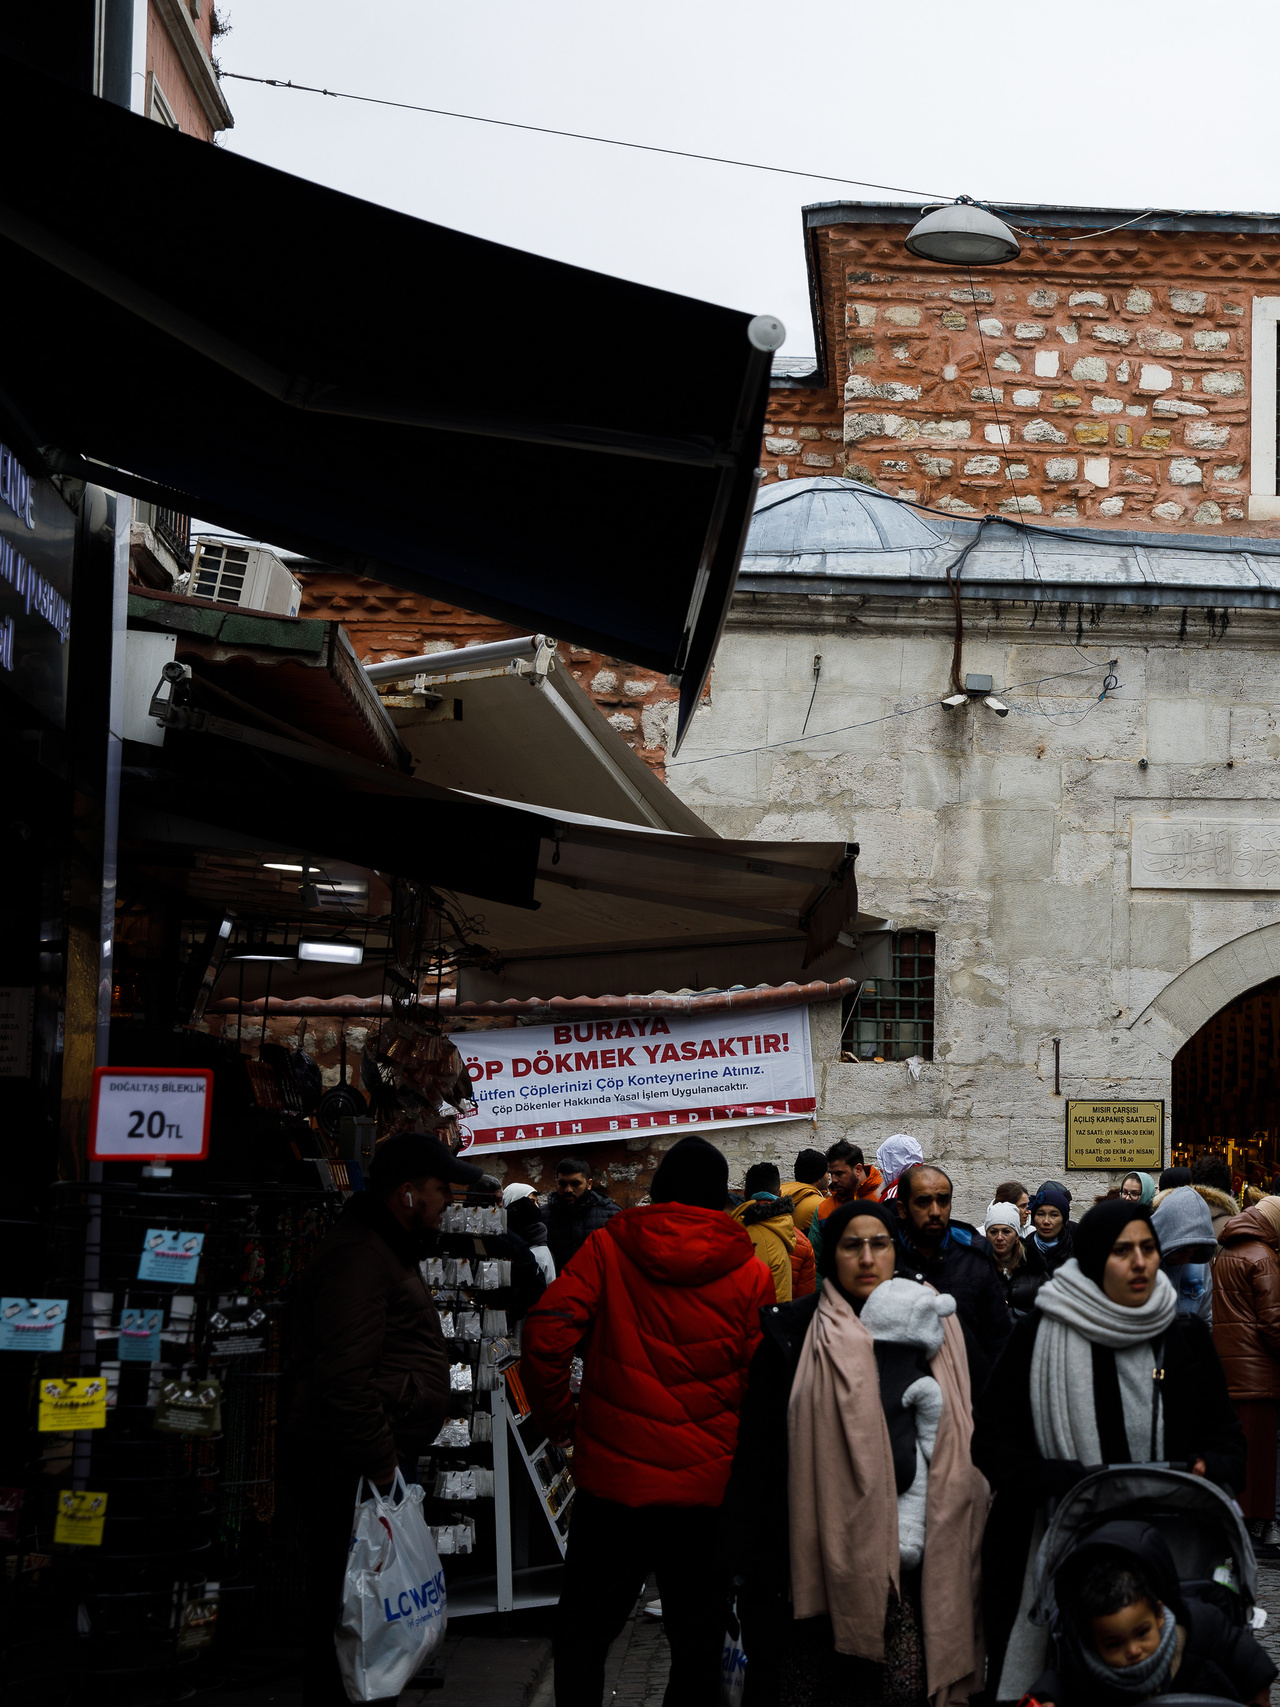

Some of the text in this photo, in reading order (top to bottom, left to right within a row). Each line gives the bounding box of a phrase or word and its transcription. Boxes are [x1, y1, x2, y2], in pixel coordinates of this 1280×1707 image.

[553, 1016, 671, 1046] BURAYA
[466, 1032, 790, 1083] ÖP DÖKMEK YASAKTIR!
[109, 1081, 206, 1093] DOĞALTAŞ BİLEKLİK
[472, 1065, 765, 1102] Lütfen Çöplerinizi Çöp Konteynerine Atınız.
[491, 1105, 513, 1116] Çöp
[515, 1101, 560, 1112] Dökenler
[563, 1094, 612, 1107] Hakkında
[613, 1091, 640, 1102] Yasal
[642, 1089, 669, 1101] İşlem
[671, 1082, 749, 1098] Uygulanacaktır.
[1112, 1106, 1139, 1115] ÇARŞISI
[127, 1110, 183, 1139] 20 TL
[496, 1101, 790, 1142] FATİH BELEDİYESİ
[1073, 1115, 1157, 1124] AÇILIŞ KAPANIŞ SAATLERİ
[1139, 1128, 1155, 1136] EKİM)
[1136, 1147, 1155, 1155] NİSAN)
